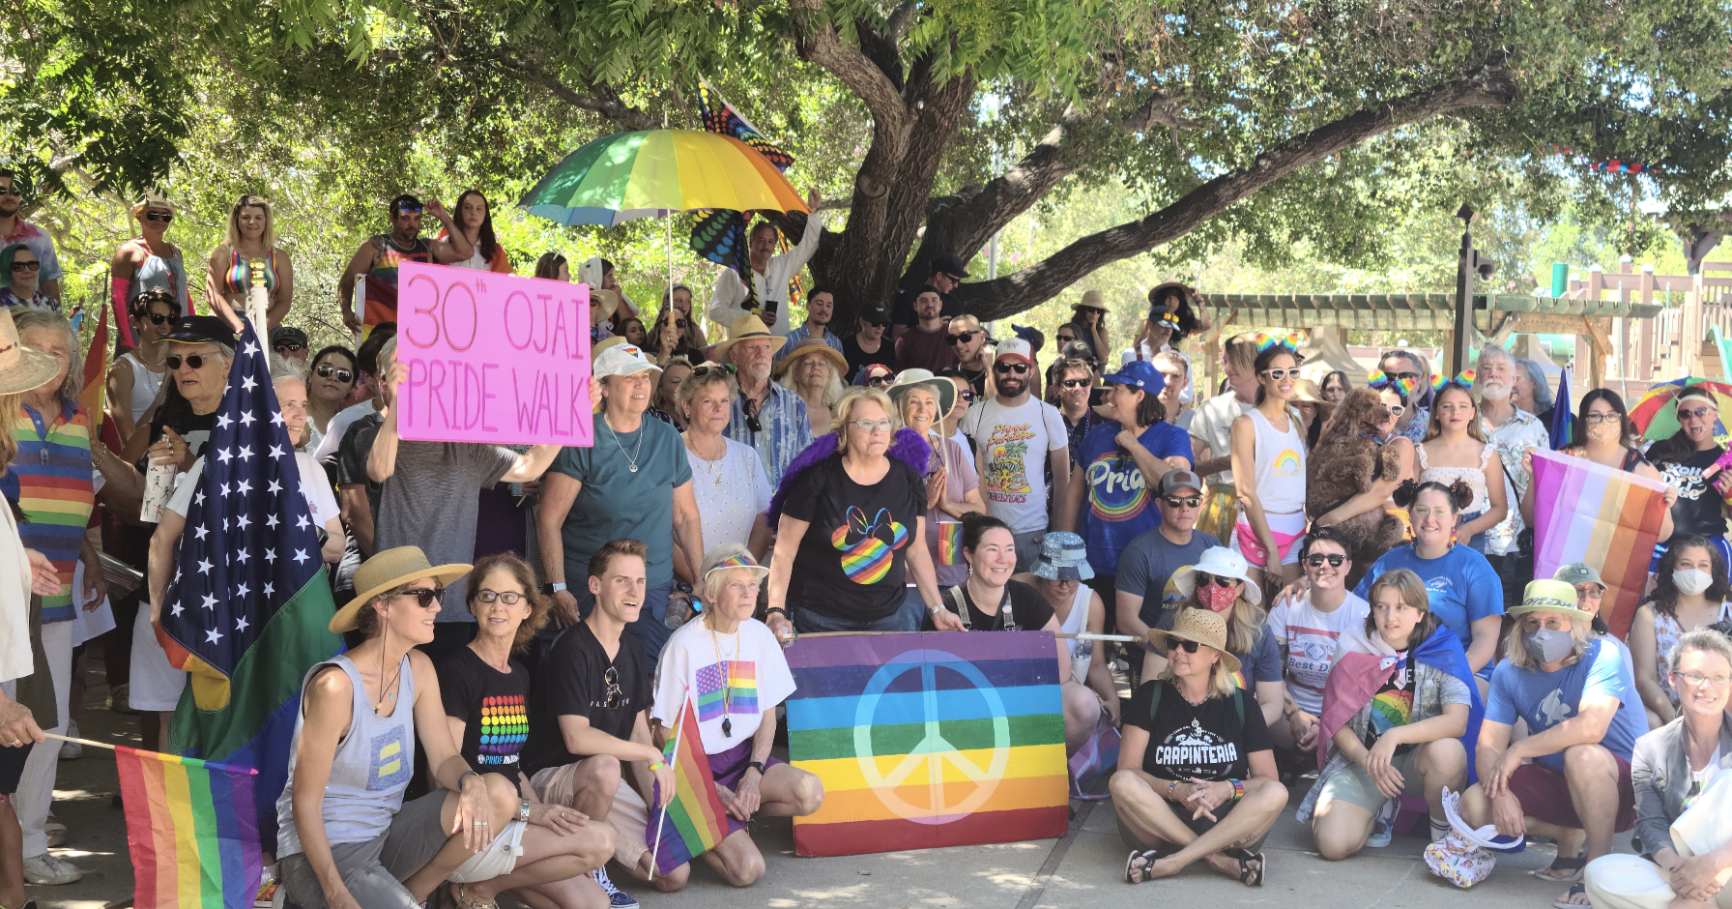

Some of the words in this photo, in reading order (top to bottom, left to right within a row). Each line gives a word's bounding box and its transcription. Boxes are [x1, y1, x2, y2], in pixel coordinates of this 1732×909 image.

[405, 274, 487, 353] 30th
[503, 290, 584, 360] OJAI
[407, 358, 499, 432] PRIDE
[512, 367, 587, 438] WALK
[1085, 460, 1151, 503] Prid
[1288, 657, 1314, 670] Best
[1318, 663, 1329, 673] D
[485, 754, 503, 765] PRIDE
[1156, 742, 1238, 765] CARPINTERIA
